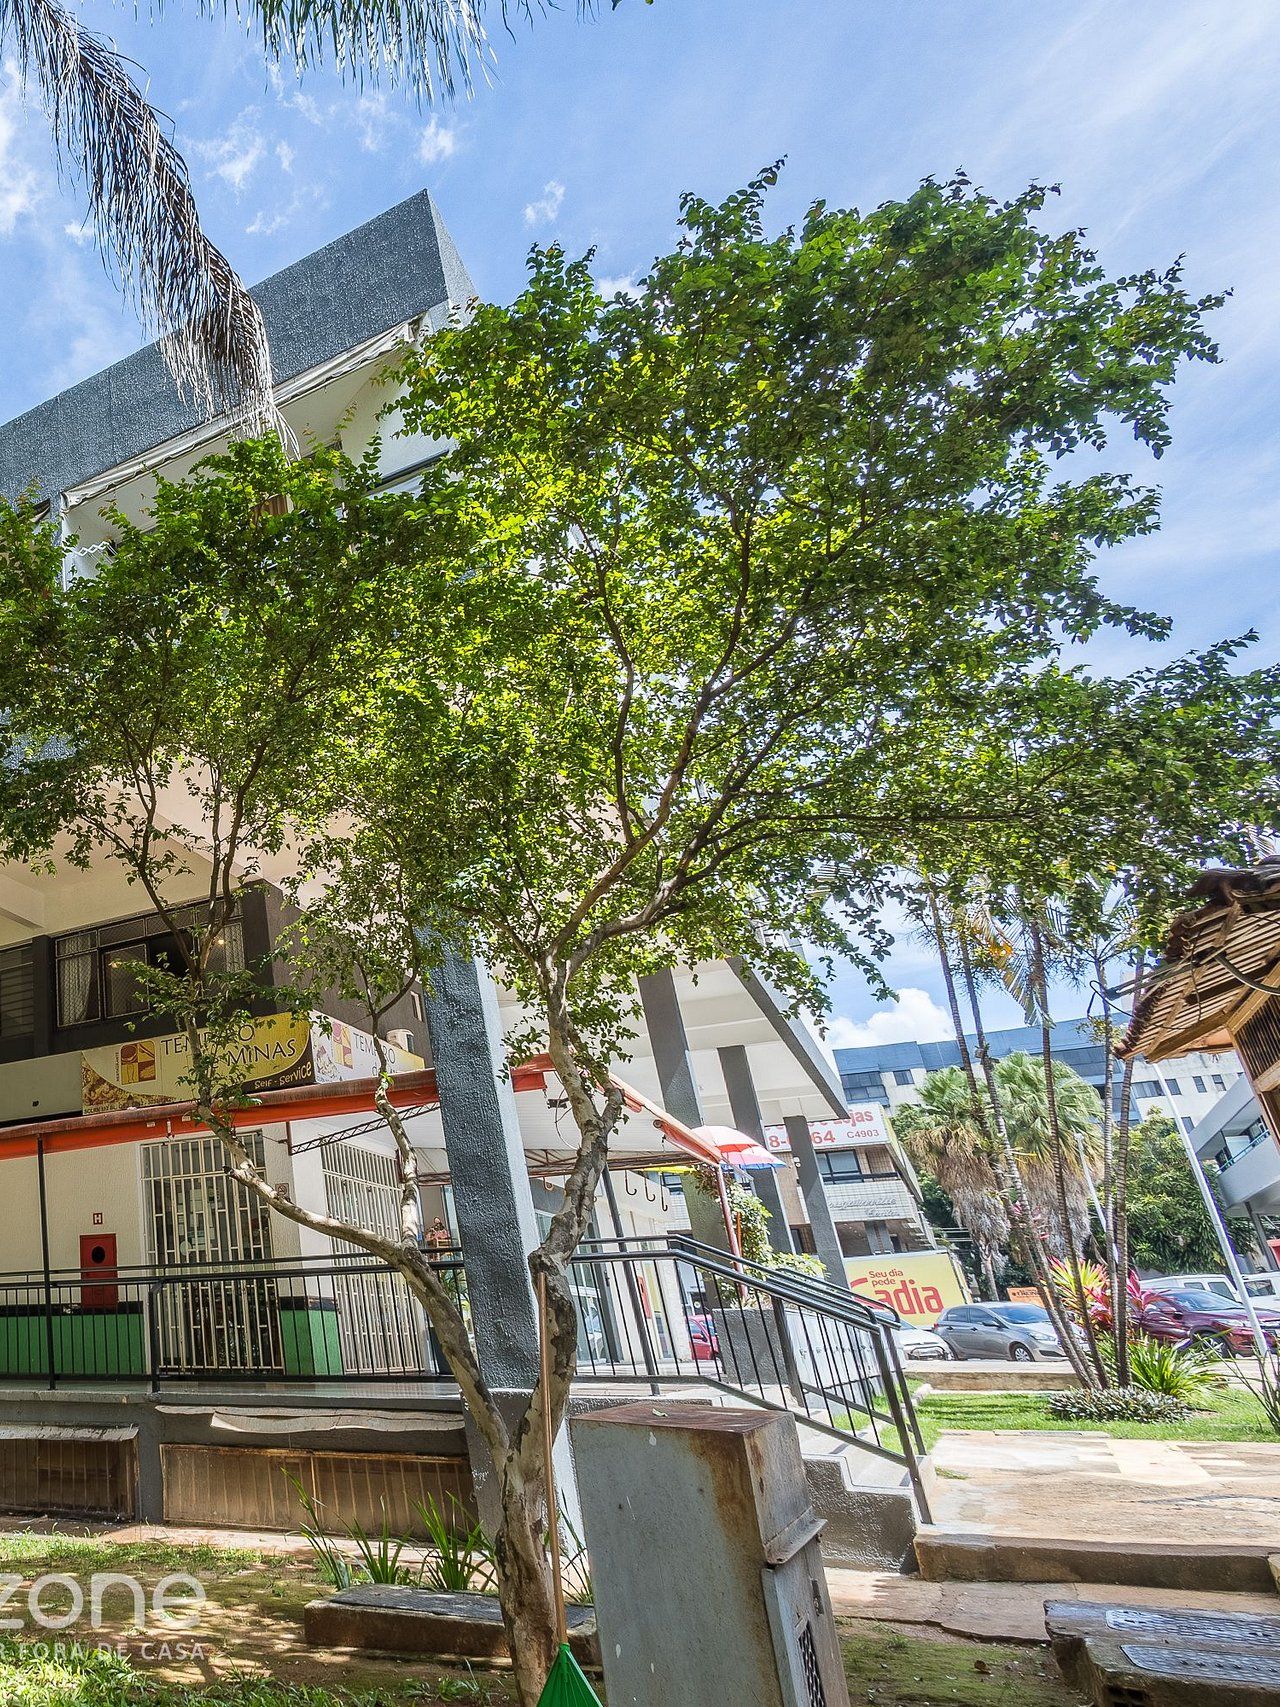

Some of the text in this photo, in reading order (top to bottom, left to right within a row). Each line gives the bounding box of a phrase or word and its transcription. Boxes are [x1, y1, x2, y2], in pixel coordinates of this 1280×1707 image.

[226, 1038, 297, 1066] MINAS
[279, 1061, 312, 1086] Service
[847, 1129, 880, 1139] C4903
[868, 1268, 904, 1279] Seu dia
[871, 1277, 897, 1288] pede
